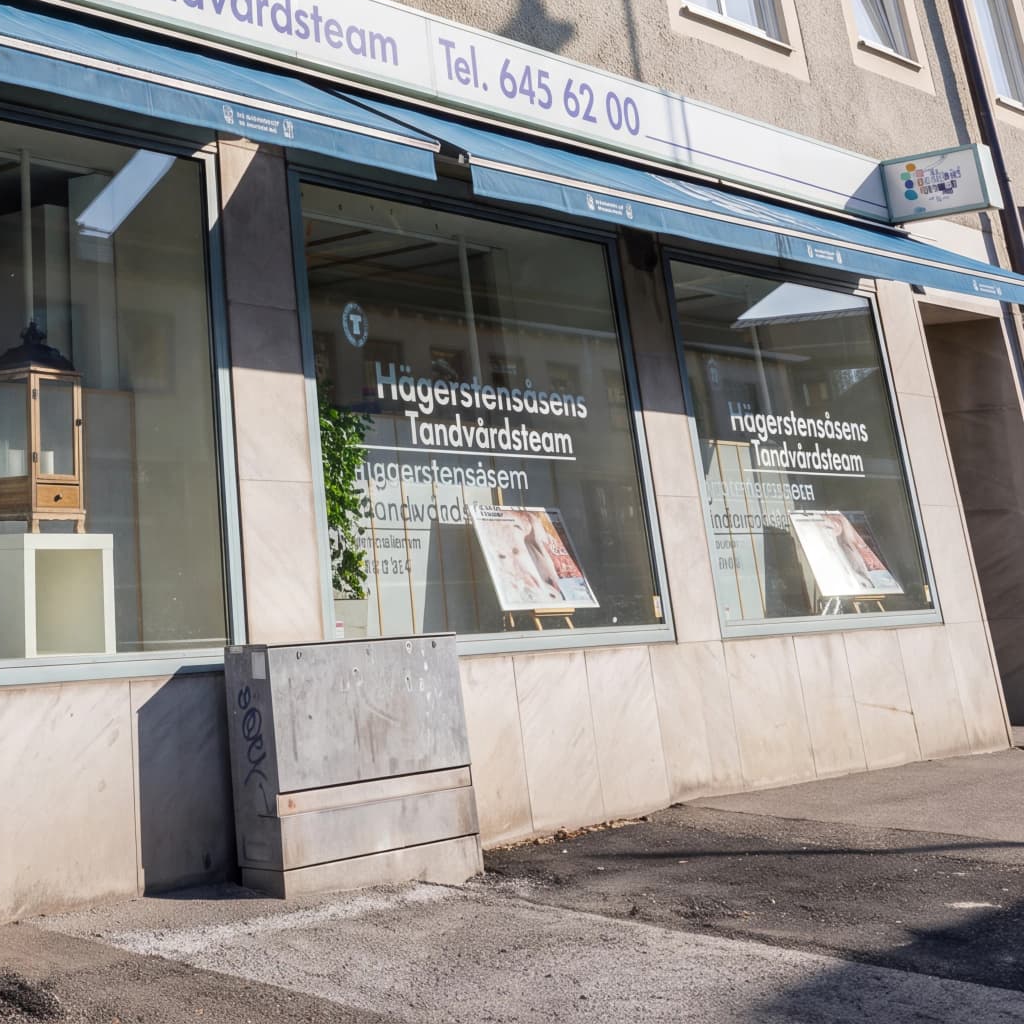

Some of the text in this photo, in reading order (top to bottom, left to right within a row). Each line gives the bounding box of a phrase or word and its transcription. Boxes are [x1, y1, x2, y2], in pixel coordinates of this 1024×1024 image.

[438, 38, 489, 92] Tel.
[499, 58, 553, 111] 645
[563, 77, 598, 124] 62
[605, 90, 641, 137] 00
[375, 361, 588, 419] Hägerstensåsens
[405, 410, 574, 454] Tandvårdsteam
[728, 401, 869, 442] Hägerstensåsens
[750, 439, 864, 472] Tandvårdsteam
